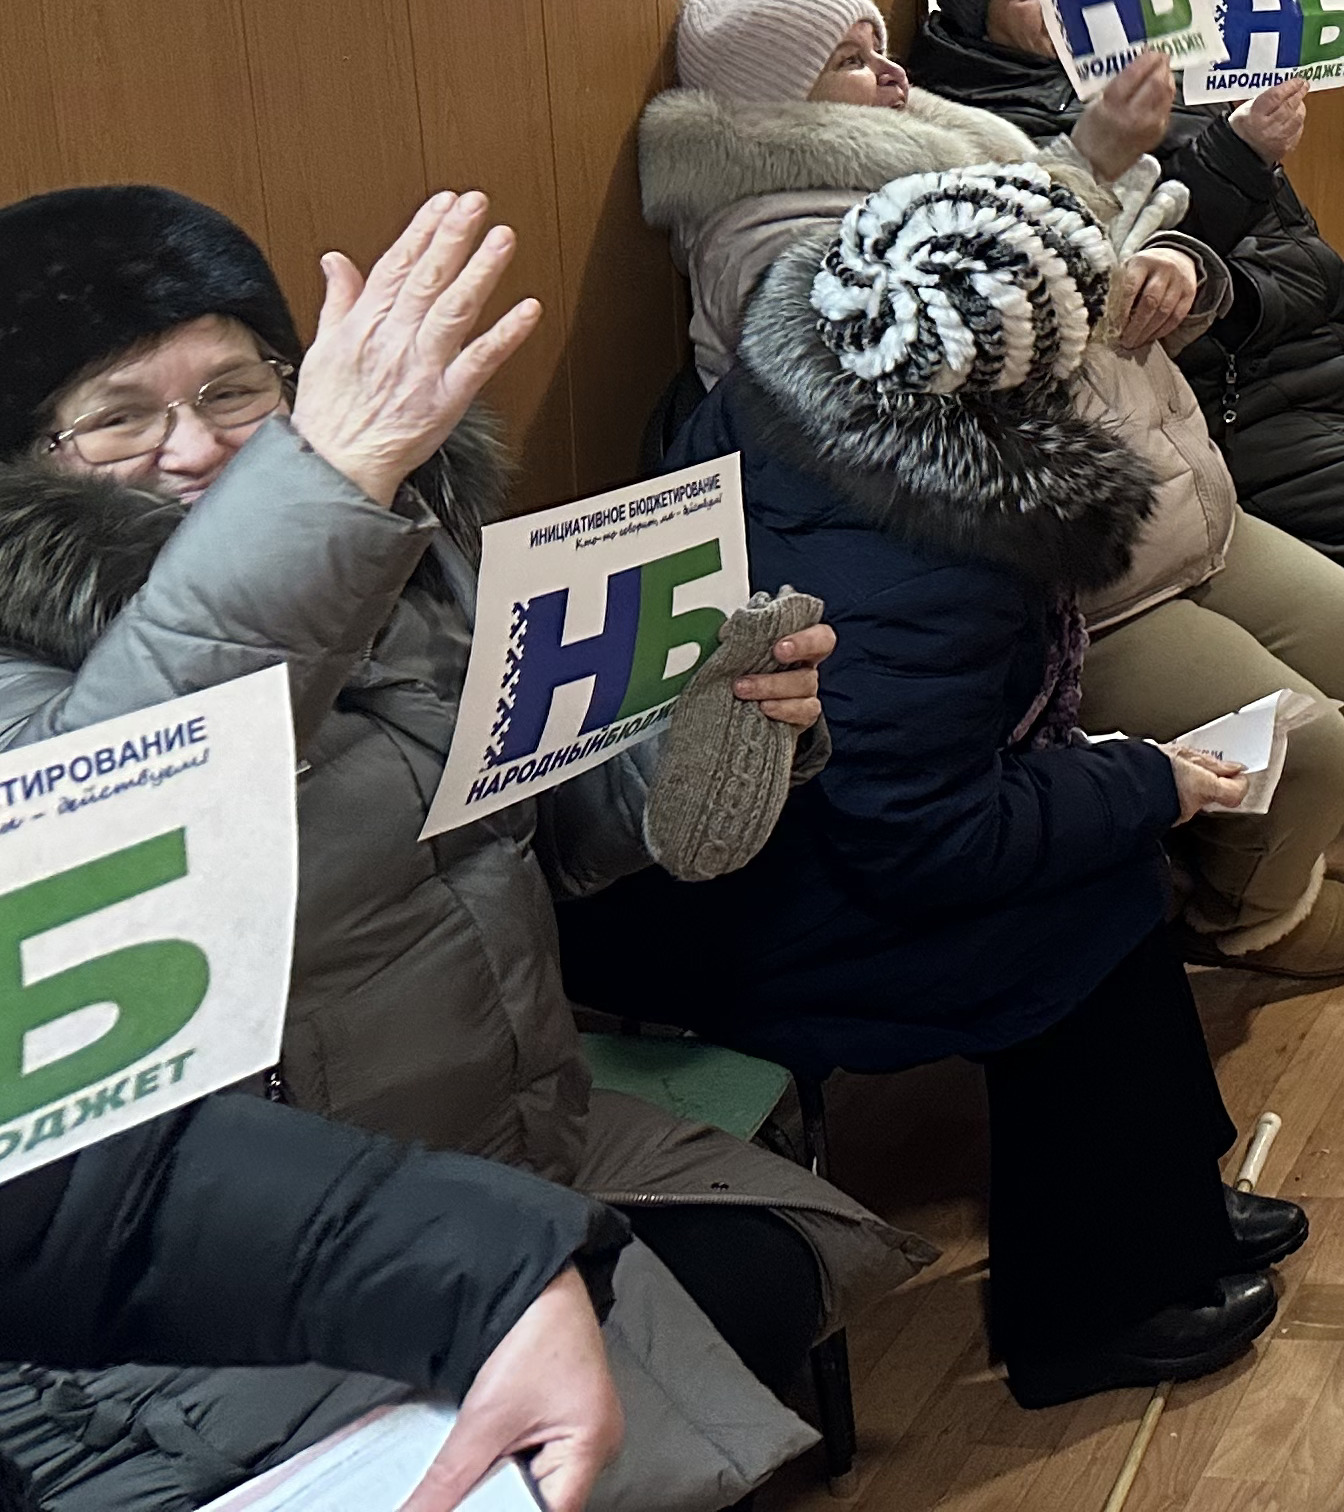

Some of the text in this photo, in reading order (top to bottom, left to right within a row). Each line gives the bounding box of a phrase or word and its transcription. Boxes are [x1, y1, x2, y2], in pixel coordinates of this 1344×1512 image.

[530, 473, 721, 549] ИНИЦИАТИВНОЕ БЮДЖЕТИРОВАНИЕ
[482, 538, 728, 772] НБ
[465, 700, 678, 805] НАРОДНЫЙБЮДЖ
